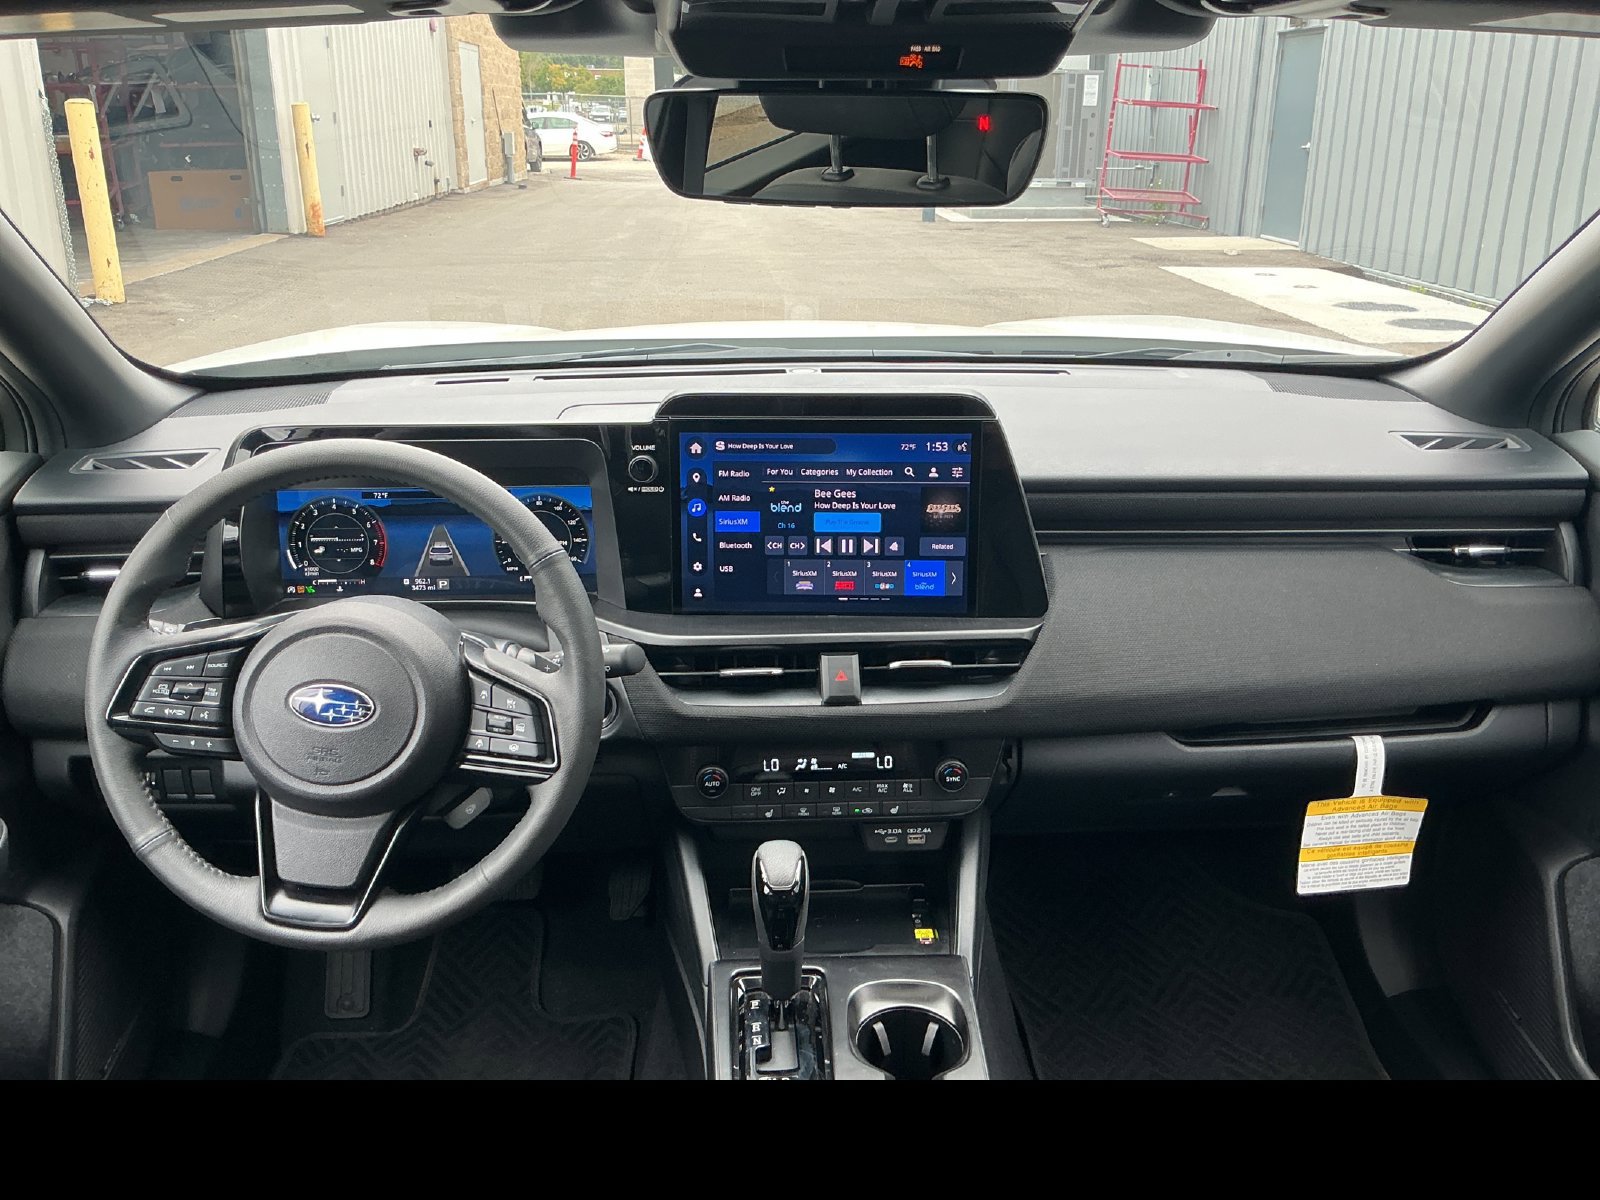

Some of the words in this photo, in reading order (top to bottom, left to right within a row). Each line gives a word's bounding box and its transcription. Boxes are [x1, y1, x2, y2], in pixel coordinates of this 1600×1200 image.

[978, 115, 991, 131] N
[926, 442, 948, 452] 1:53
[800, 468, 839, 478] Categories
[846, 468, 856, 478] My
[814, 490, 832, 498] Bee
[834, 490, 857, 498] Gees
[770, 502, 802, 512] blend
[832, 502, 851, 510] Deep
[763, 758, 780, 772] LO
[876, 756, 893, 769] LO
